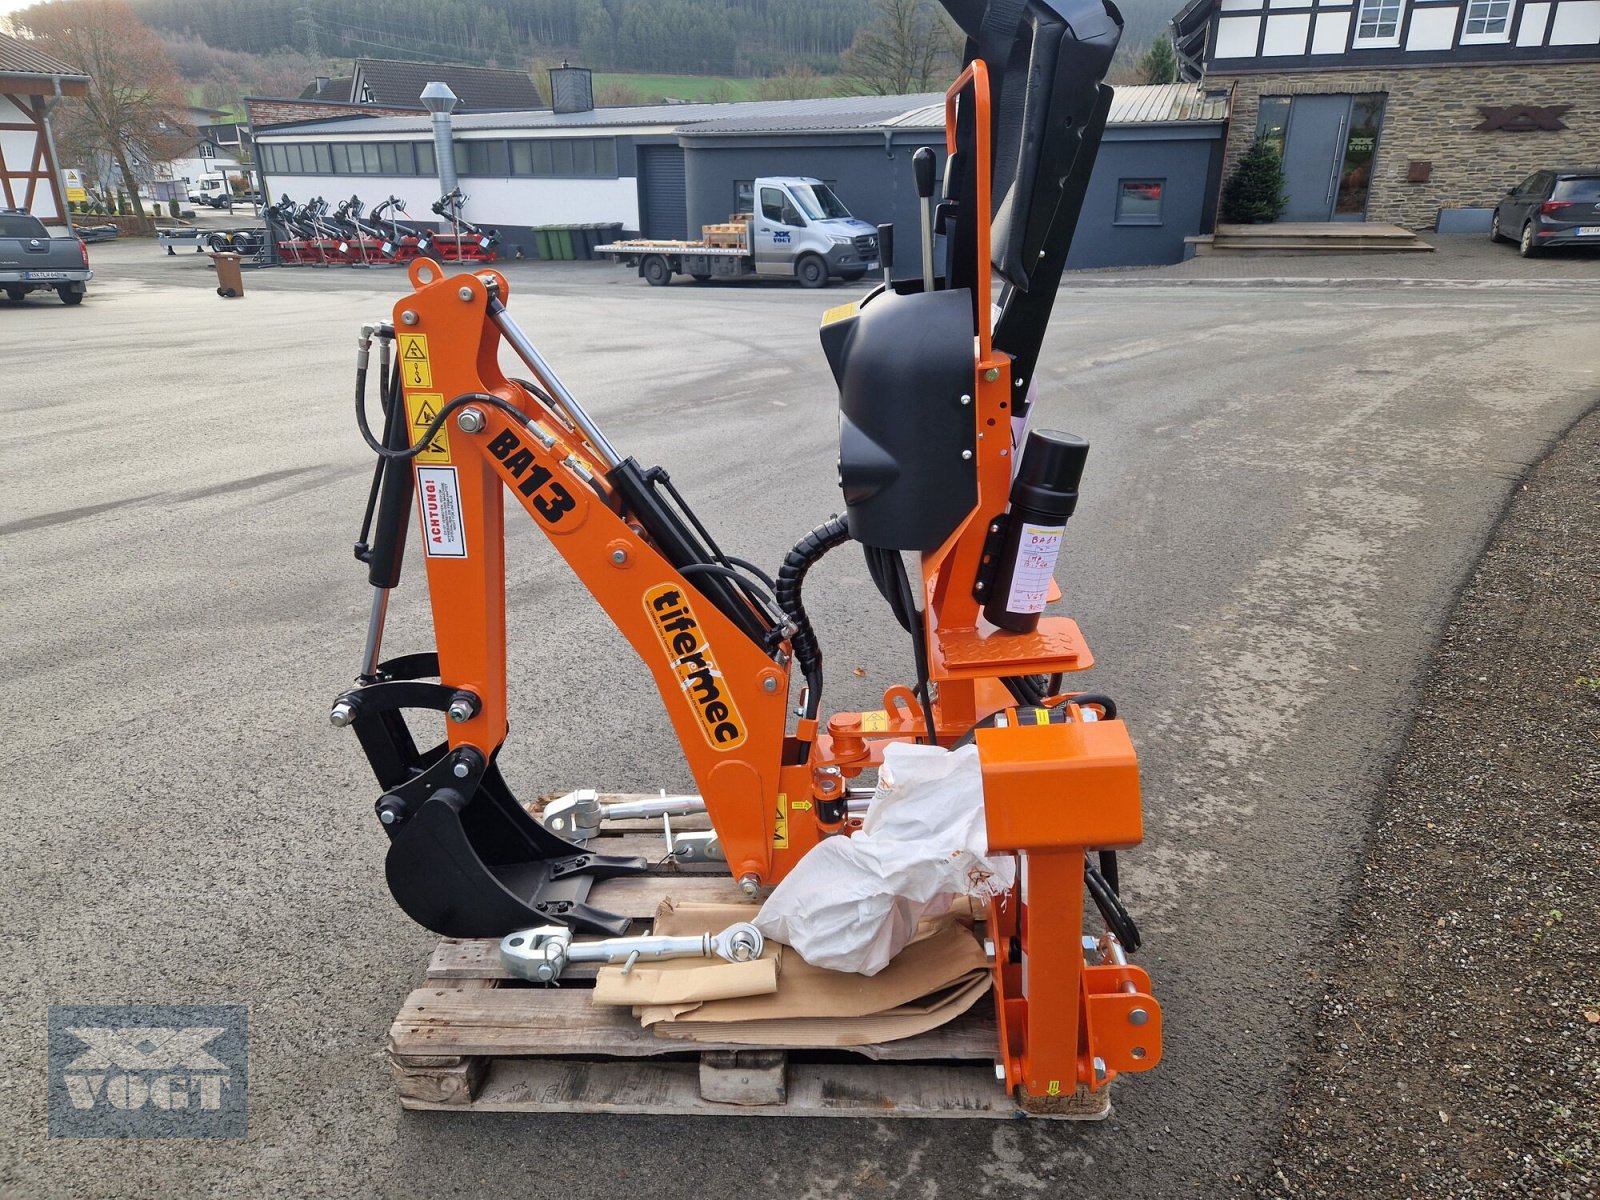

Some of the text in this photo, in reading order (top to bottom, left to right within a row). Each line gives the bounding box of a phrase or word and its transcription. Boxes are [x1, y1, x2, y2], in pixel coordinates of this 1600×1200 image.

[425, 480, 442, 543] ACHTUNG!
[486, 427, 576, 524] BA13
[652, 590, 739, 743] tifermec
